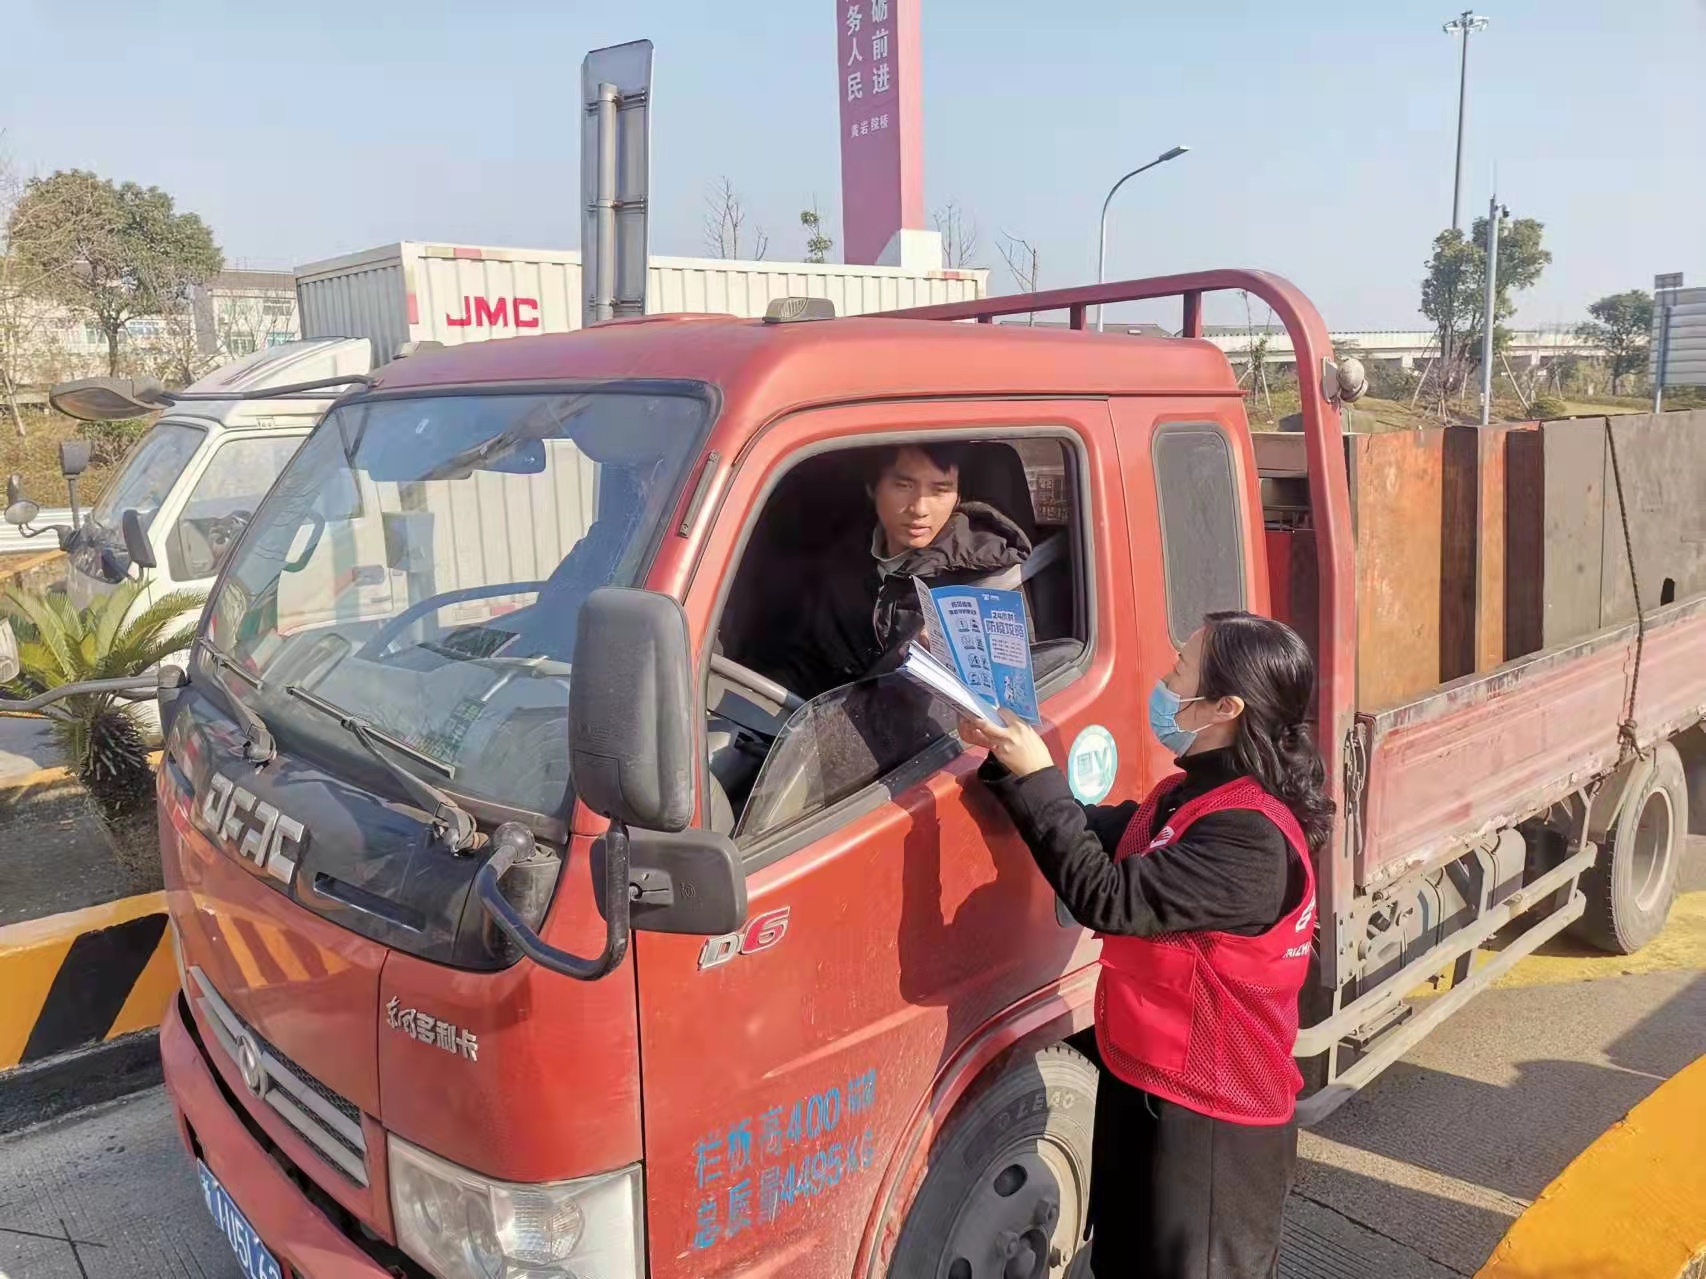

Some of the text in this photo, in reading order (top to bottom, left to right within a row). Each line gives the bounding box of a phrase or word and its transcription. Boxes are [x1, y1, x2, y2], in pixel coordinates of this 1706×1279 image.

[846, 0, 863, 102] 务人民
[446, 295, 539, 328] JMC
[697, 905, 791, 971] D6
[386, 995, 478, 1062] 东风多利卡
